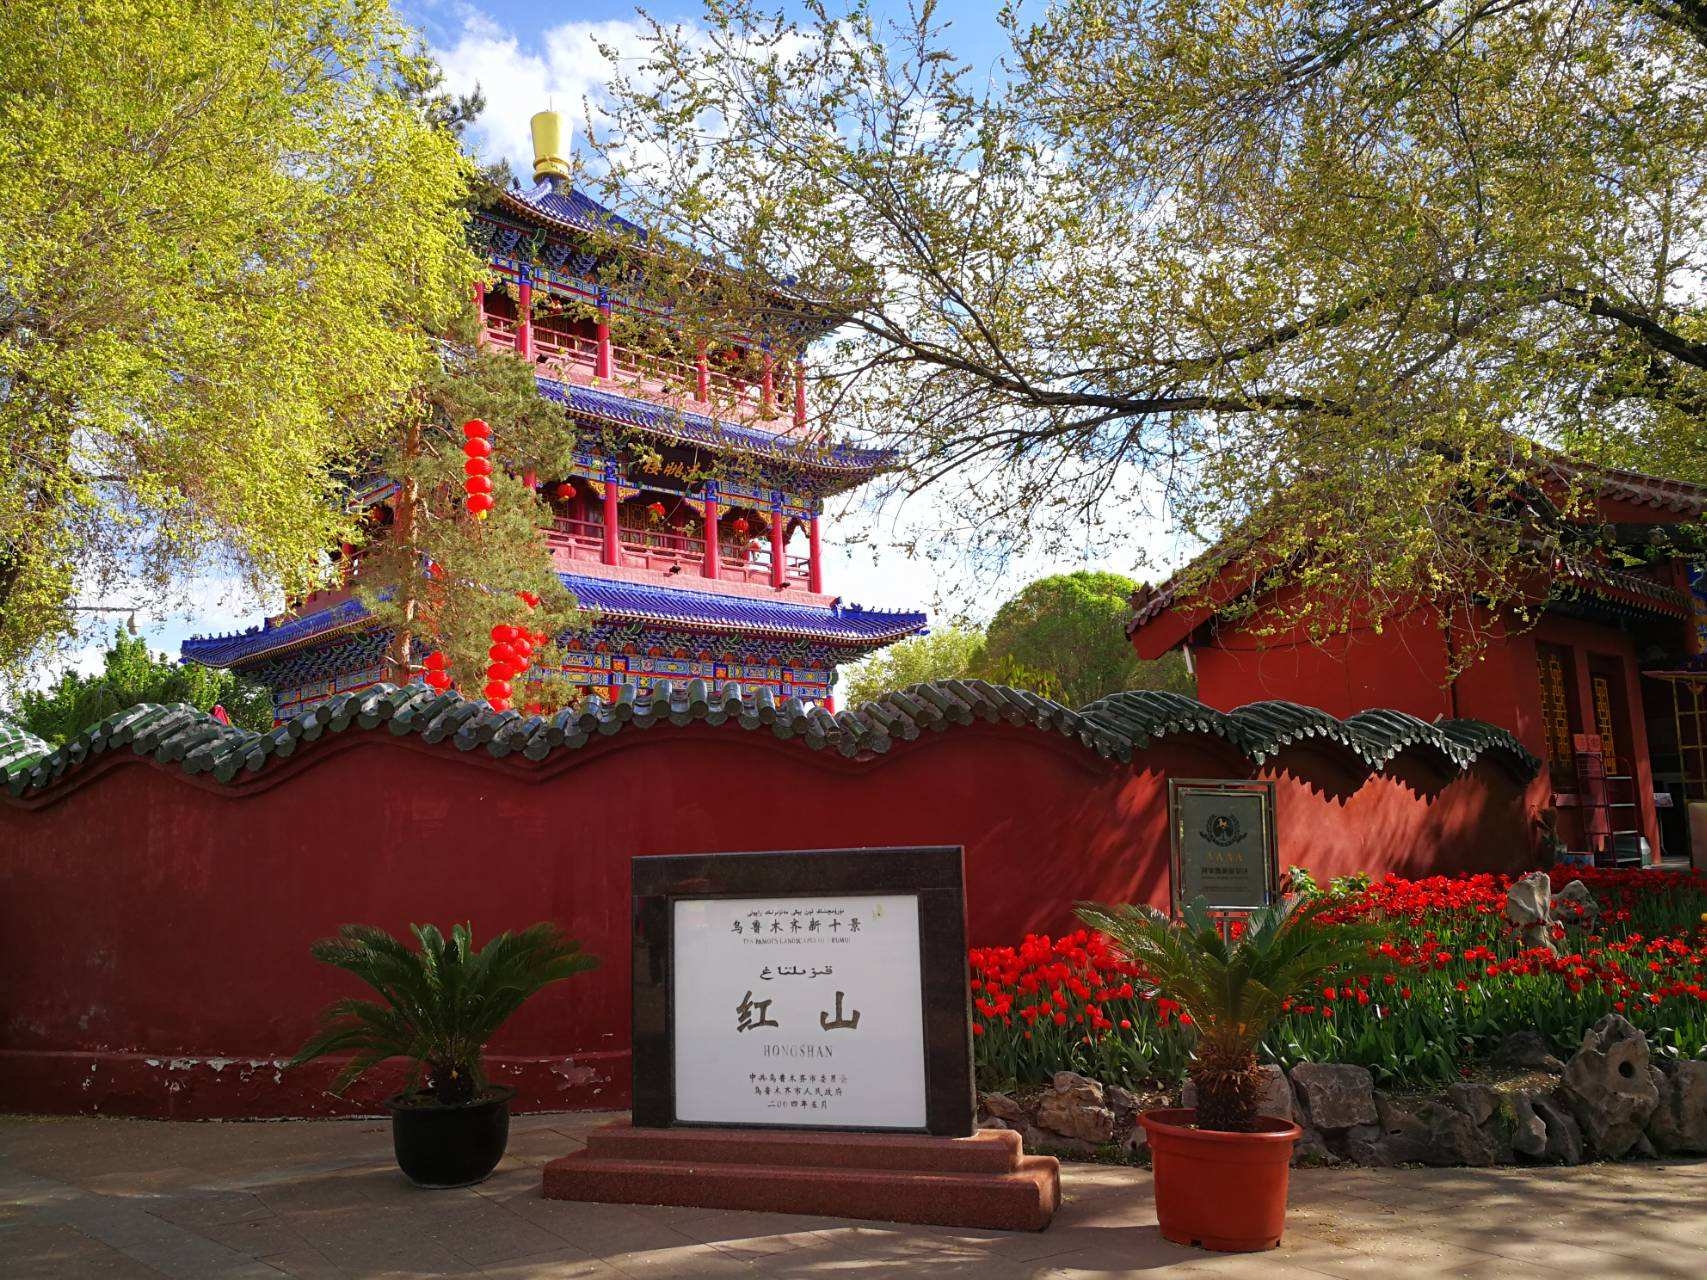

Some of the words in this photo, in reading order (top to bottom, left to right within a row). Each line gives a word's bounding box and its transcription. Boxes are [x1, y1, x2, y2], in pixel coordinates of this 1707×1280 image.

[731, 917, 862, 934] 乌鲁木齐新十景
[736, 991, 861, 1033] 红山
[763, 1045, 833, 1058] HONGSHAN
[754, 1086, 843, 1097] 乌鲁木齐市人民政府
